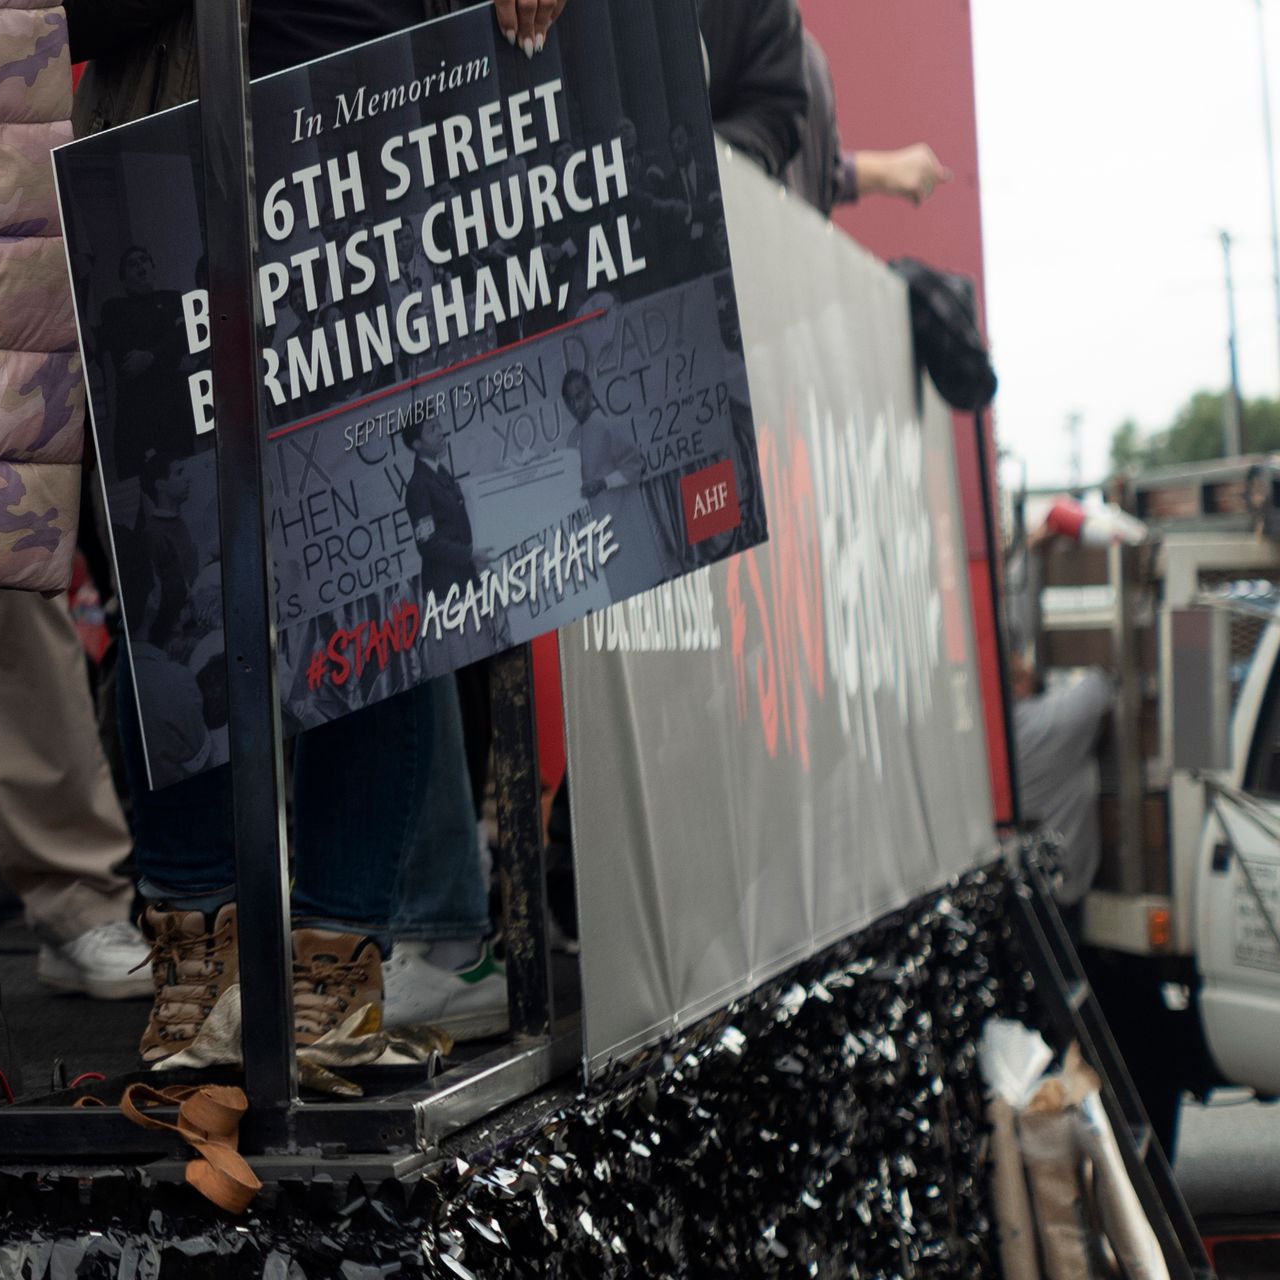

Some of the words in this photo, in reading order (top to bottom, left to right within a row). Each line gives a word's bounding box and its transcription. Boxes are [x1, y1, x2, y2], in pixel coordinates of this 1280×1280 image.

[291, 106, 324, 144] In
[333, 55, 490, 130] Memoriam
[380, 78, 563, 202] STREET
[181, 216, 404, 355] BPTIST
[419, 136, 630, 267] CHURCH
[188, 248, 571, 436] BRMINGHAM,
[586, 216, 647, 287] AL
[343, 389, 447, 452] SEPTEMBER
[452, 381, 478, 410] 15,
[484, 361, 524, 398] 1963
[692, 481, 729, 520] AHF
